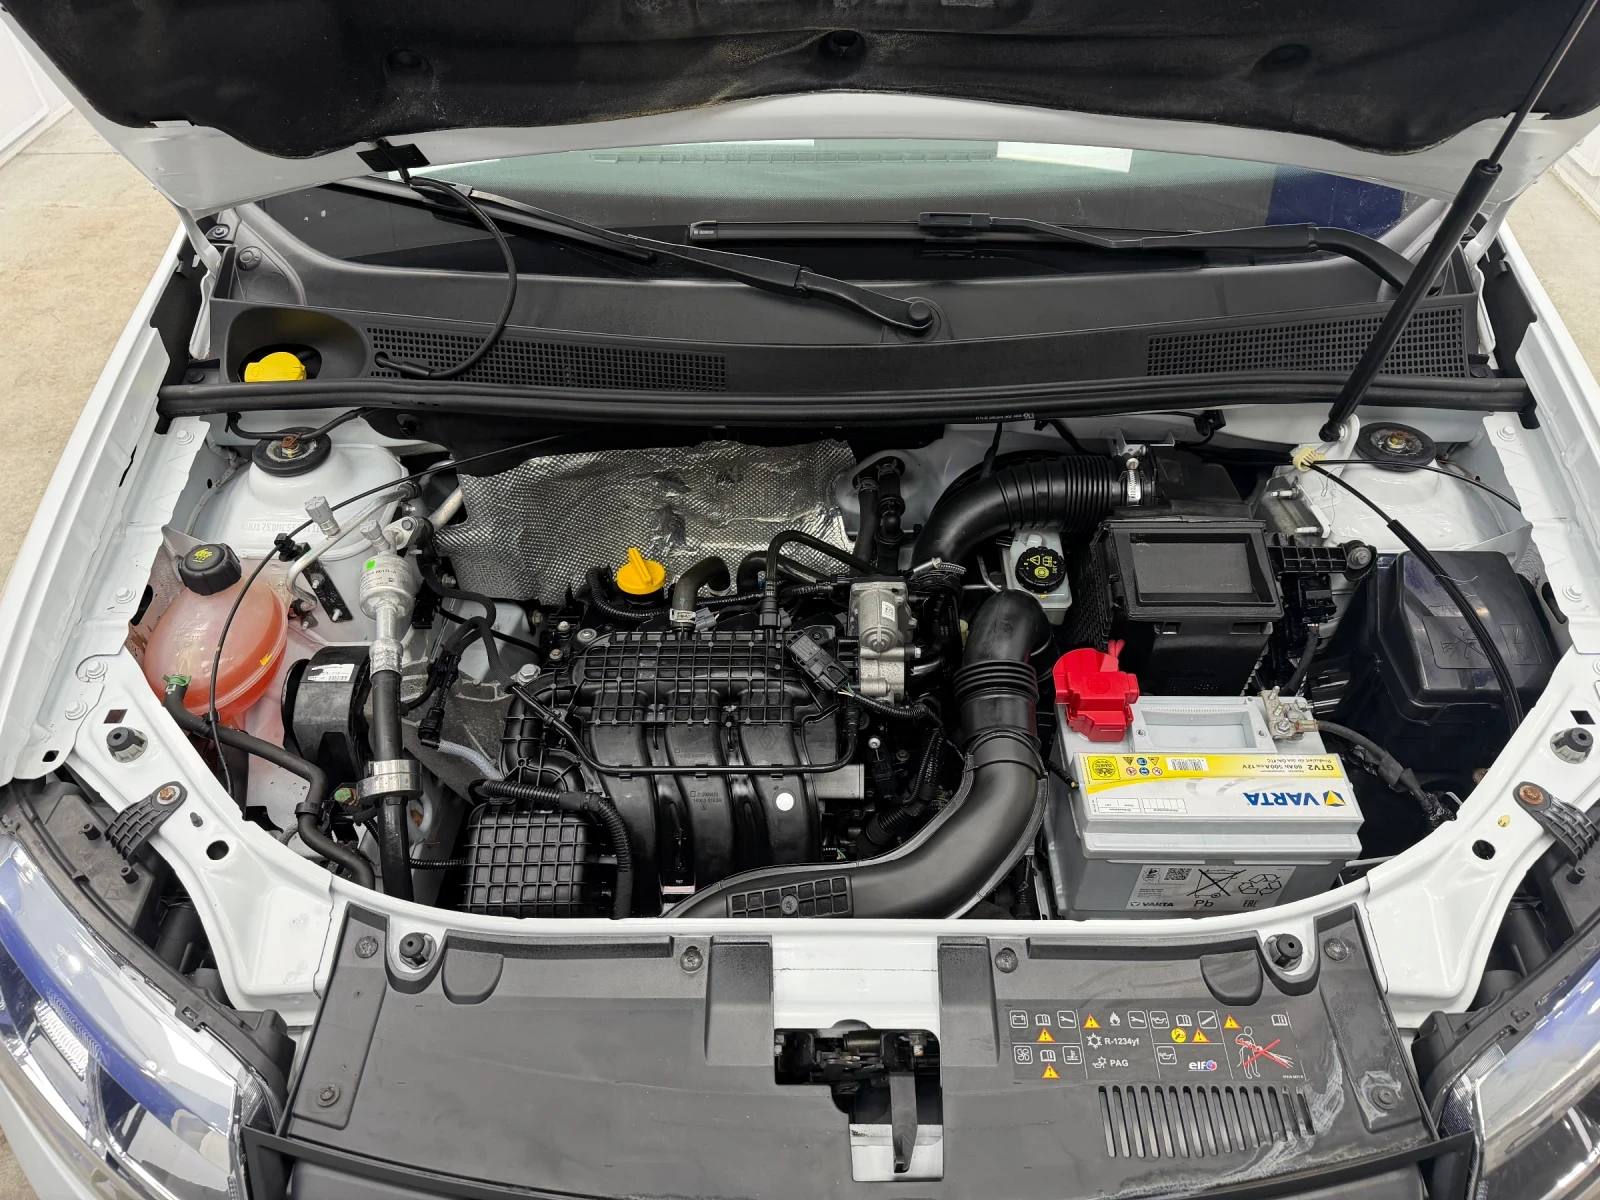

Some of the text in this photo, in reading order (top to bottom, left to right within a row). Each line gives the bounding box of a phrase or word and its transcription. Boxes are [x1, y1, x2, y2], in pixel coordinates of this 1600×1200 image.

[1243, 792, 1320, 806] VARTA
[1194, 900, 1214, 908] Pb
[1104, 1037, 1140, 1046] R-1234yf
[1110, 1059, 1129, 1067] PAG
